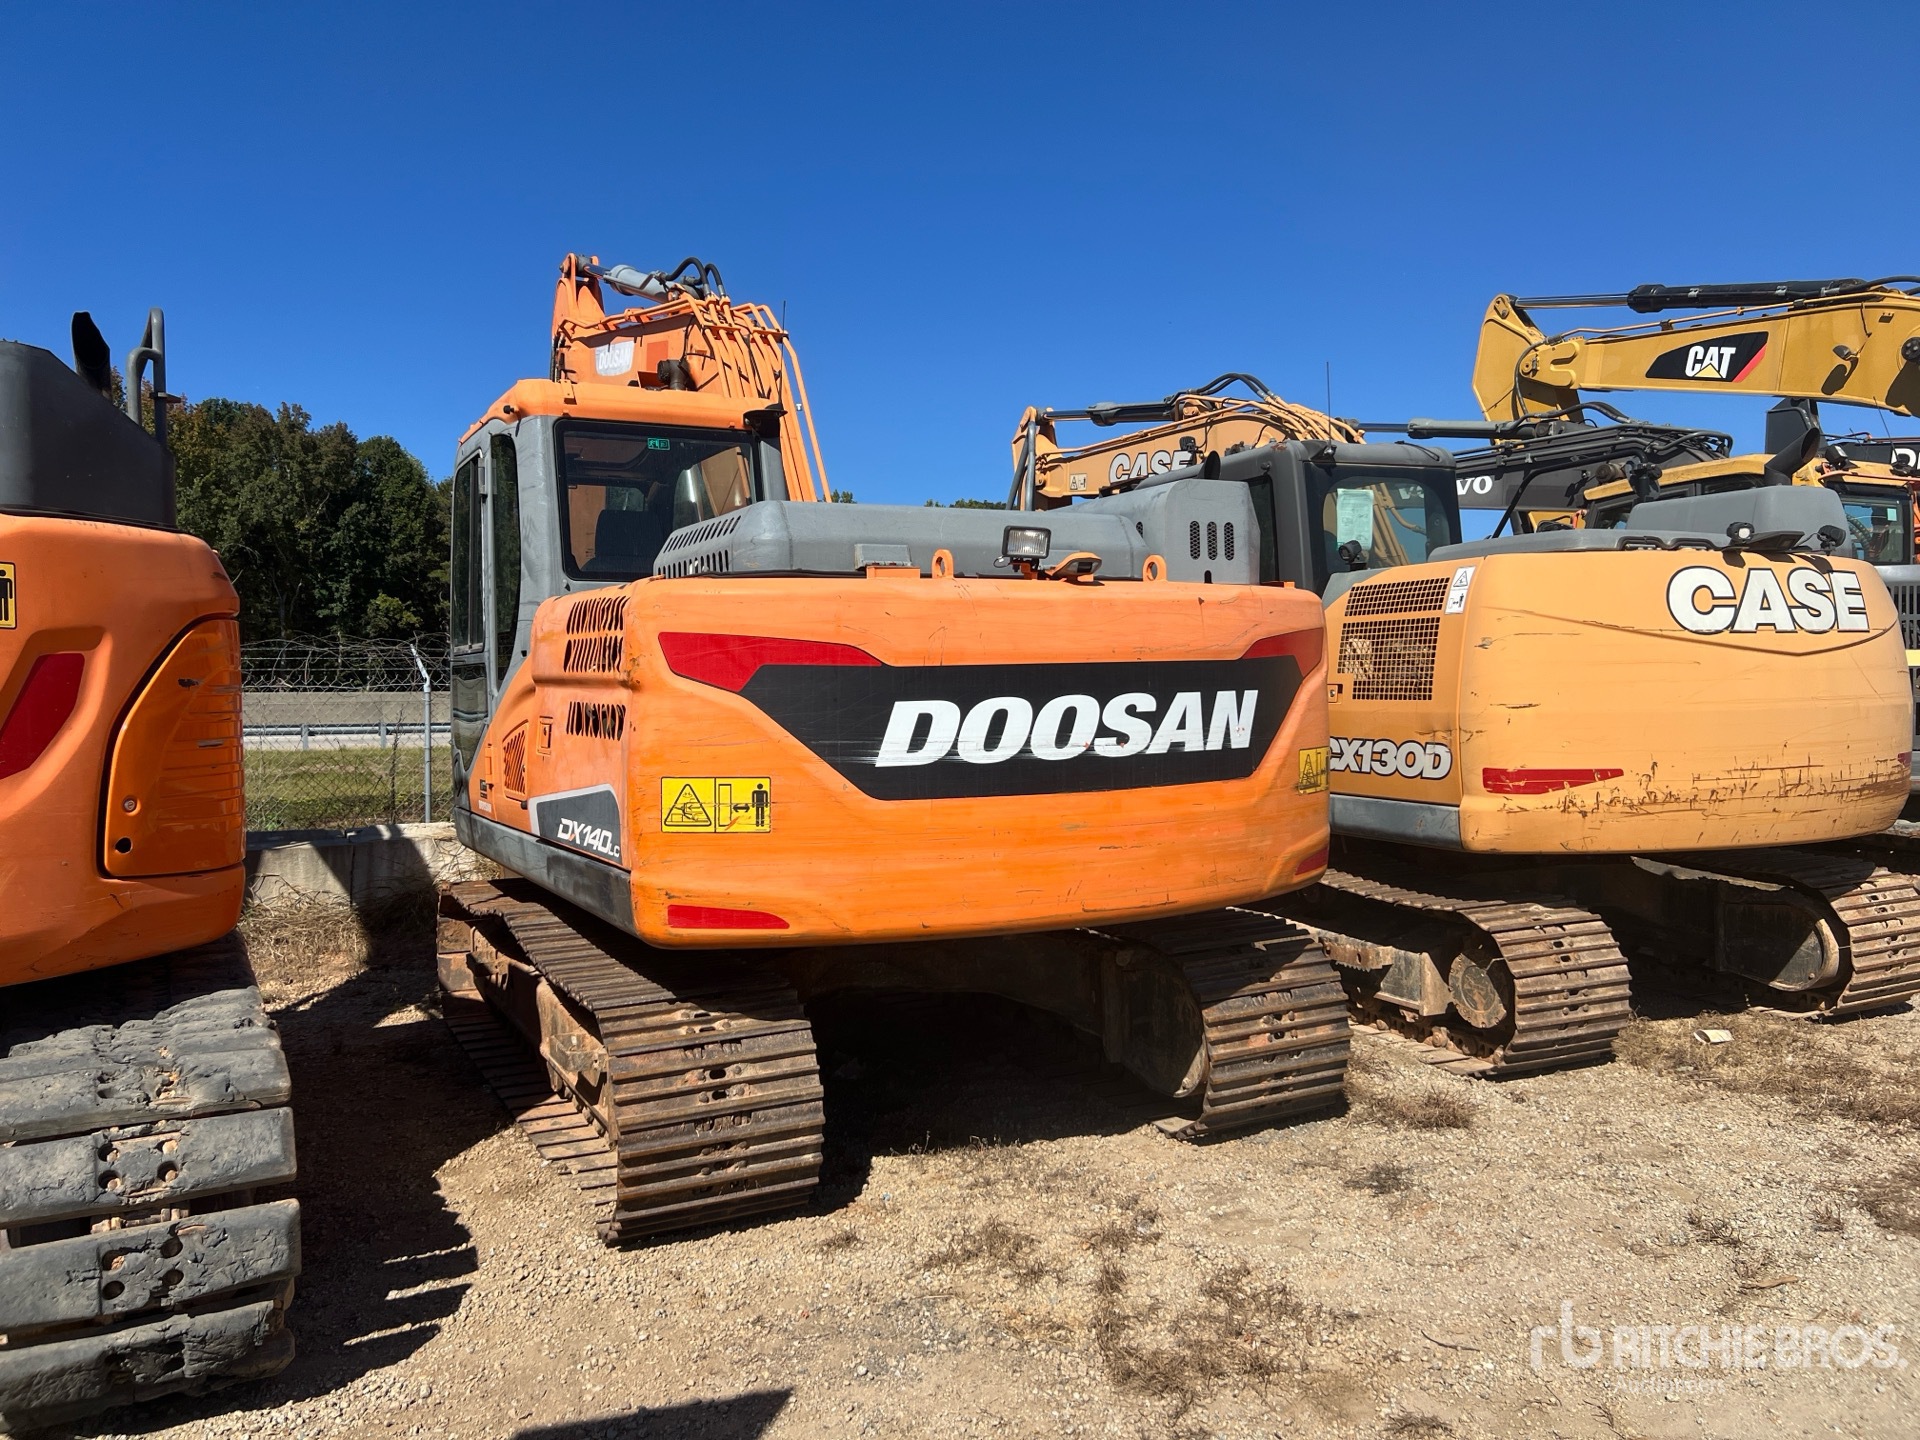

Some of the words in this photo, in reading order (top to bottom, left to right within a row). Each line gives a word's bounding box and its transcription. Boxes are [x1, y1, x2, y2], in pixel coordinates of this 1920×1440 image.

[1685, 345, 1736, 379] CAT
[1109, 450, 1192, 486] CASE
[1890, 447, 1920, 470] D
[1666, 565, 1870, 635] CASE
[875, 689, 1259, 767] DOOSAN
